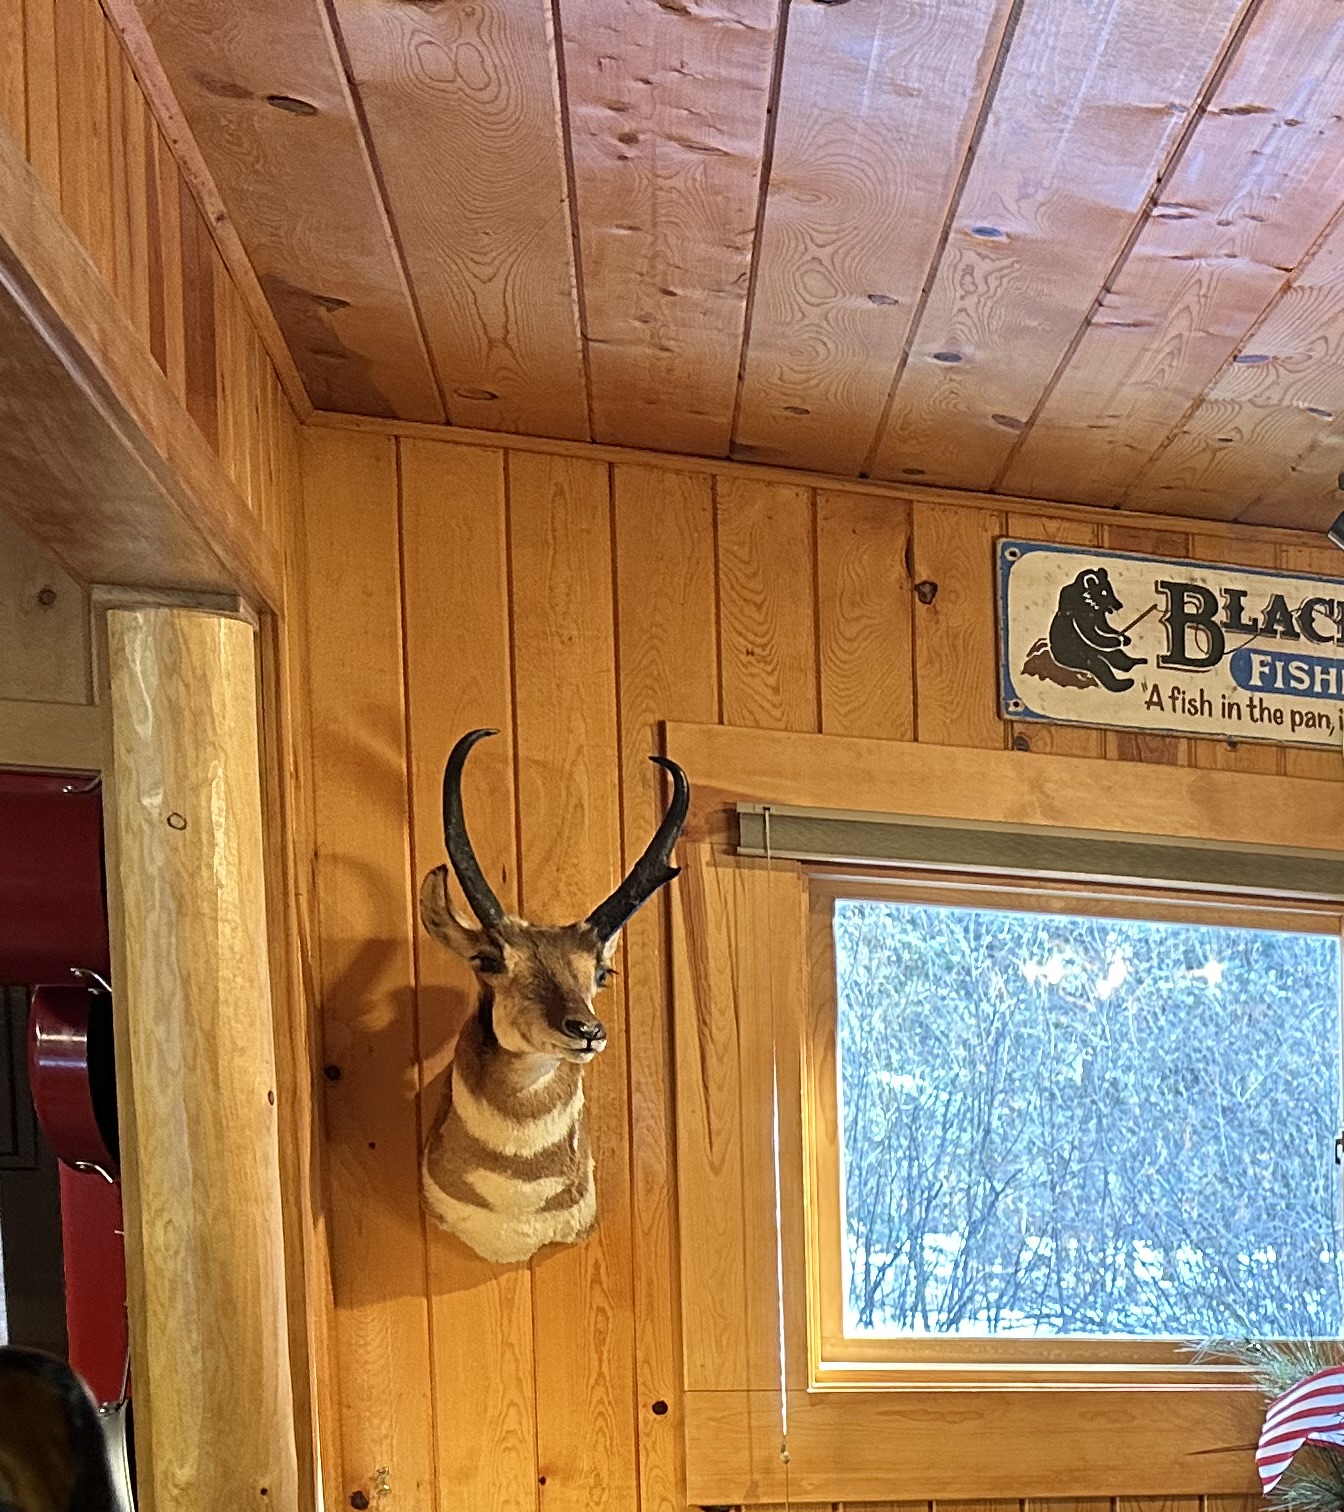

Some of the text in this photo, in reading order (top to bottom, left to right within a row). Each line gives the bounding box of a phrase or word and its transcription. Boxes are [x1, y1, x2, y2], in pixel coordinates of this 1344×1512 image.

[1169, 686, 1212, 718] fish
[1221, 694, 1242, 721] in
[1247, 697, 1284, 725] the
[1291, 708, 1335, 736] pan,
